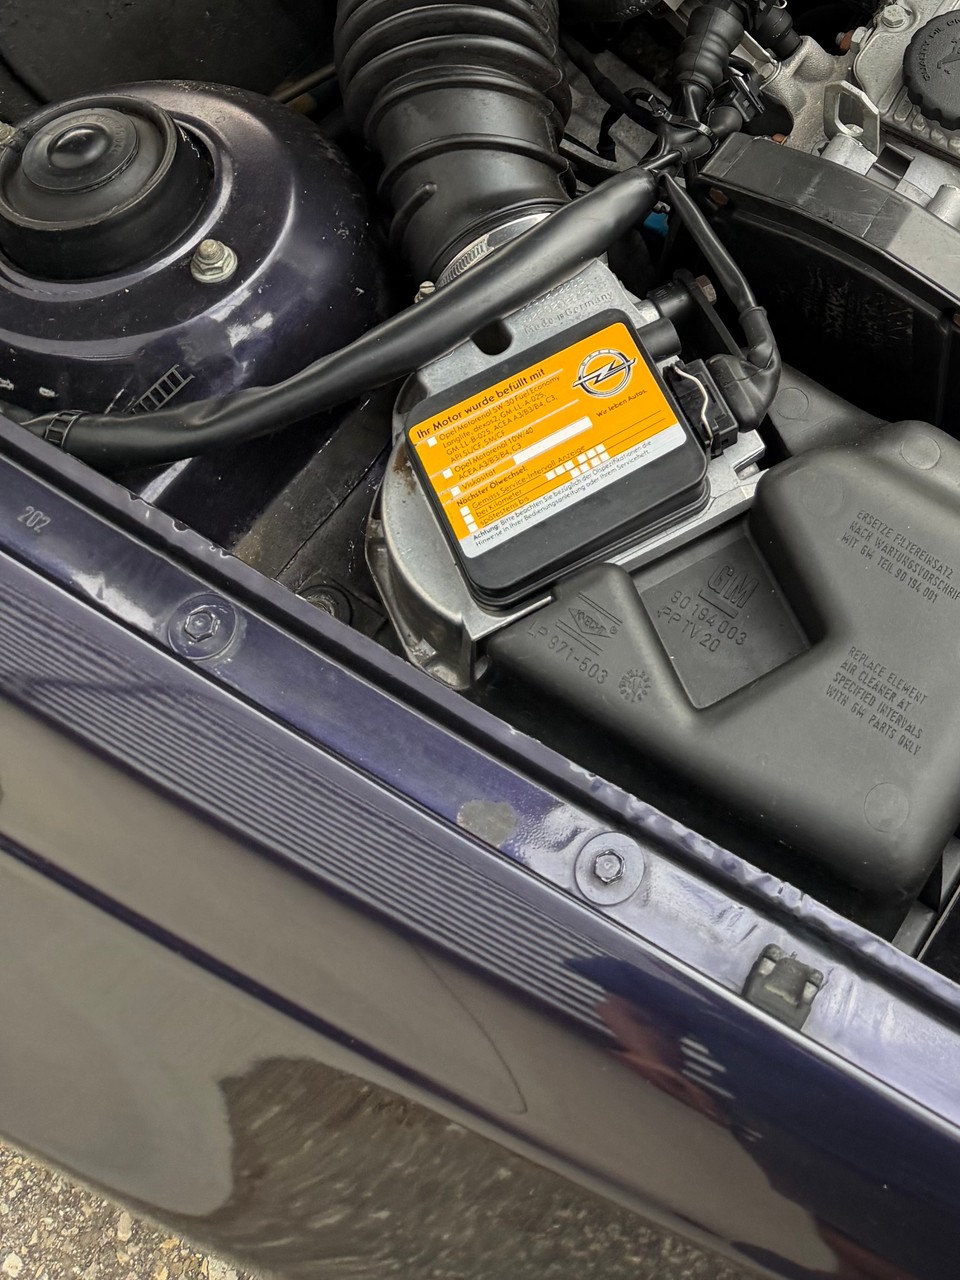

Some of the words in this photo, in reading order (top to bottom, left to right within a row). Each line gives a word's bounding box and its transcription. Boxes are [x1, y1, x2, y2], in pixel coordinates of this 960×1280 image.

[416, 425, 431, 439] Ihr
[431, 409, 463, 431] Motor
[463, 392, 496, 415] wurde
[494, 375, 528, 398] befüllt
[528, 367, 546, 381] mit
[438, 427, 458, 443] Opel
[513, 389, 530, 402] Fuel
[528, 373, 561, 396] Economy
[607, 397, 627, 412] leben
[453, 458, 473, 474] Opel
[461, 467, 496, 490] Viskosität
[455, 485, 489, 507] Nächster
[487, 487, 522, 510] Kilometer
[514, 499, 544, 518] beachten
[848, 520, 873, 542] NACH
[855, 507, 894, 538] ERSETZE
[892, 532, 955, 579] FILTEREINSATZ
[840, 531, 859, 549] MIT
[875, 555, 896, 574] TEIL
[905, 575, 924, 593] 194
[921, 586, 939, 603] 001
[706, 564, 758, 610] GM
[698, 630, 721, 653] 20
[715, 618, 748, 646] 003
[839, 657, 858, 676] AIR
[857, 669, 898, 703] CLEANER
[896, 696, 912, 713] AT
[847, 645, 887, 678] REPLACE
[886, 671, 927, 706] ELEMENT
[824, 683, 849, 707] WITH
[867, 713, 897, 740] PARTS
[896, 733, 922, 757] ONLY
[832, 670, 877, 707] SPECIFIED
[876, 700, 924, 740] INTERVALS
